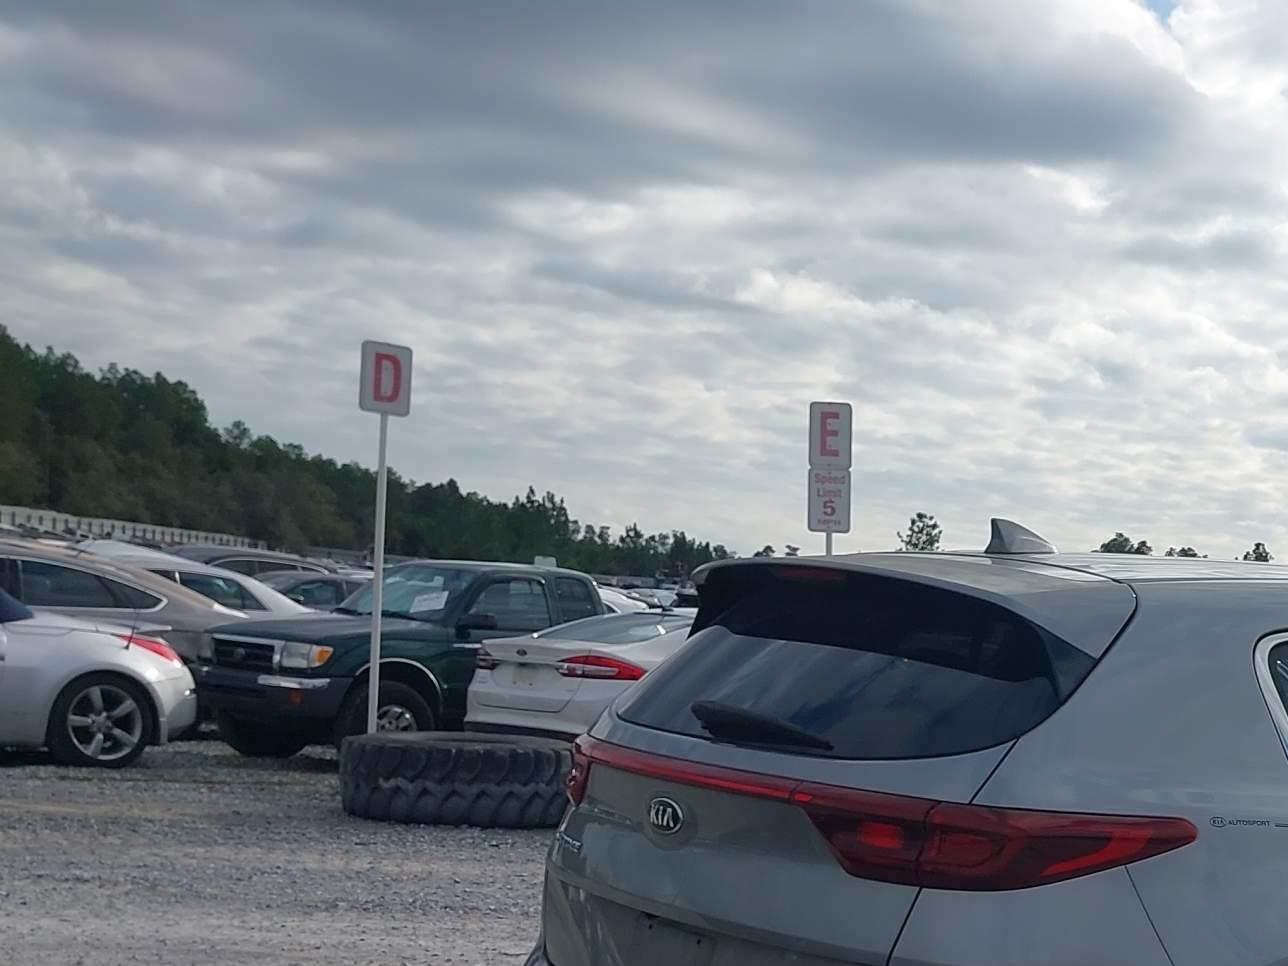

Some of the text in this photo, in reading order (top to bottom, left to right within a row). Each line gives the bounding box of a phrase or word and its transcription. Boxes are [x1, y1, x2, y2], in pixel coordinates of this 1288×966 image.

[373, 352, 402, 403] D
[820, 411, 841, 457] E
[823, 499, 836, 517] 5
[650, 803, 675, 828] KIA
